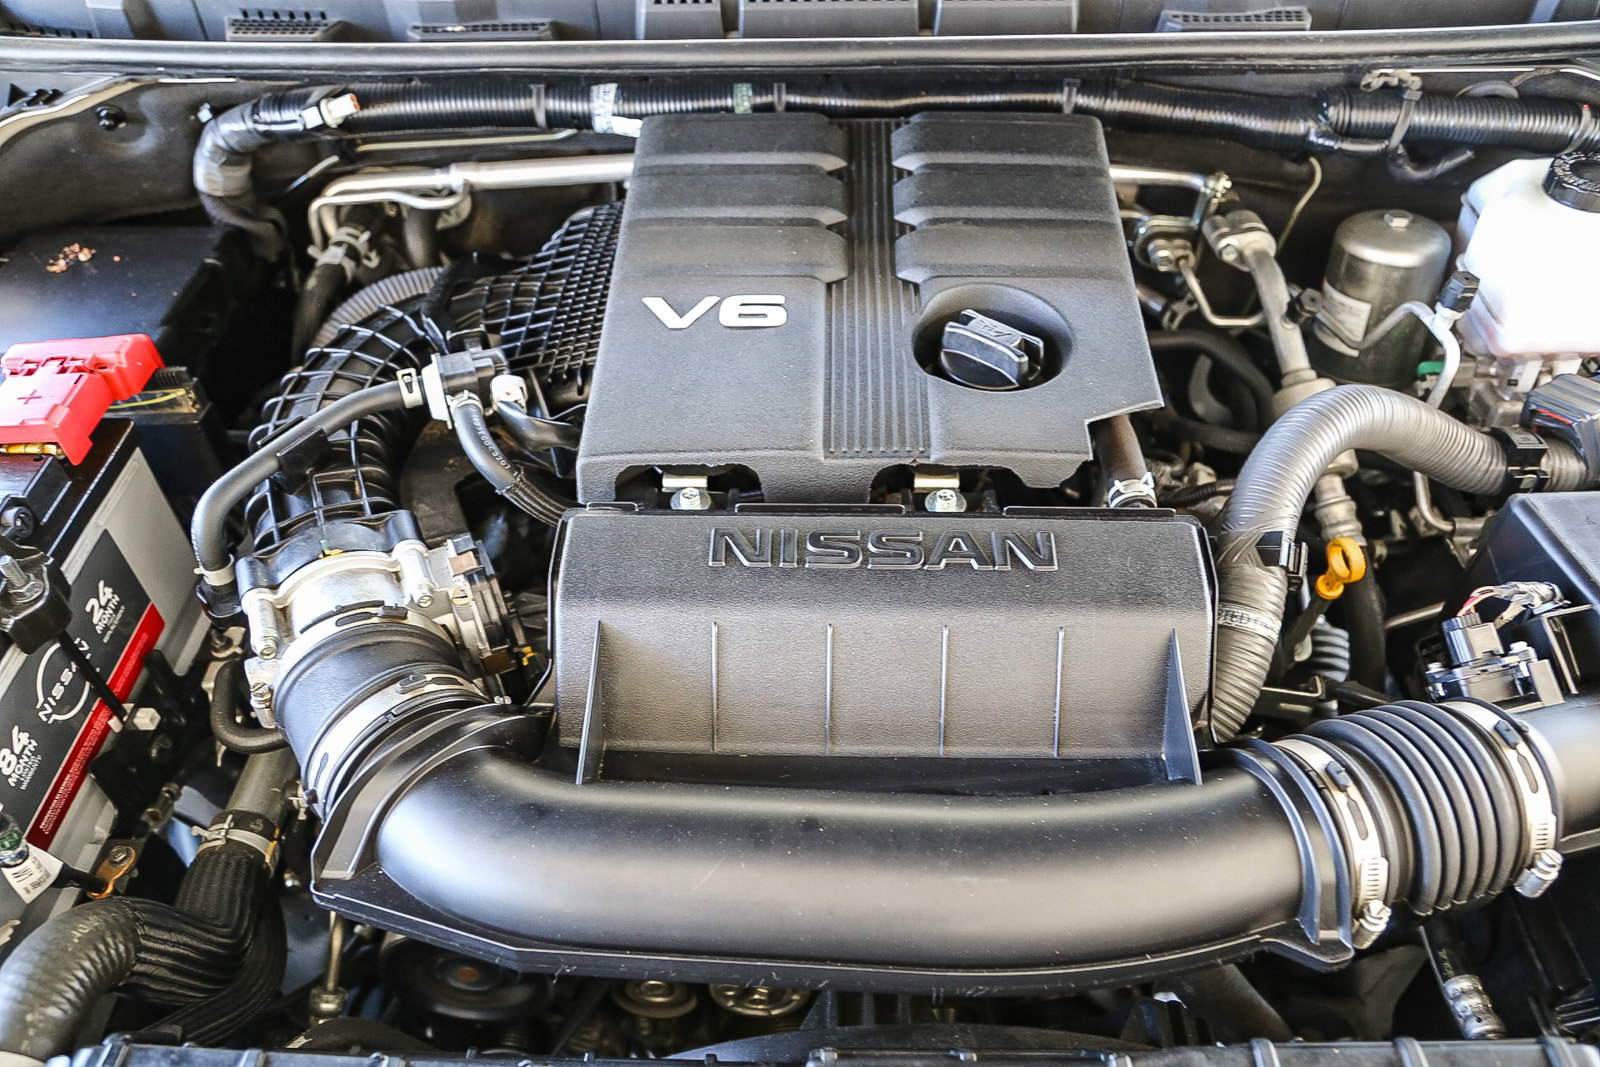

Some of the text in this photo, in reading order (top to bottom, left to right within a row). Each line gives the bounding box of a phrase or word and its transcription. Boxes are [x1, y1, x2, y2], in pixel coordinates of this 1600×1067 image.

[641, 294, 788, 330] V6
[708, 527, 1059, 572] NISSAN
[85, 580, 113, 625] 24
[95, 594, 120, 634] MONTH
[0, 725, 30, 776] 84
[8, 738, 38, 787] MONTH
